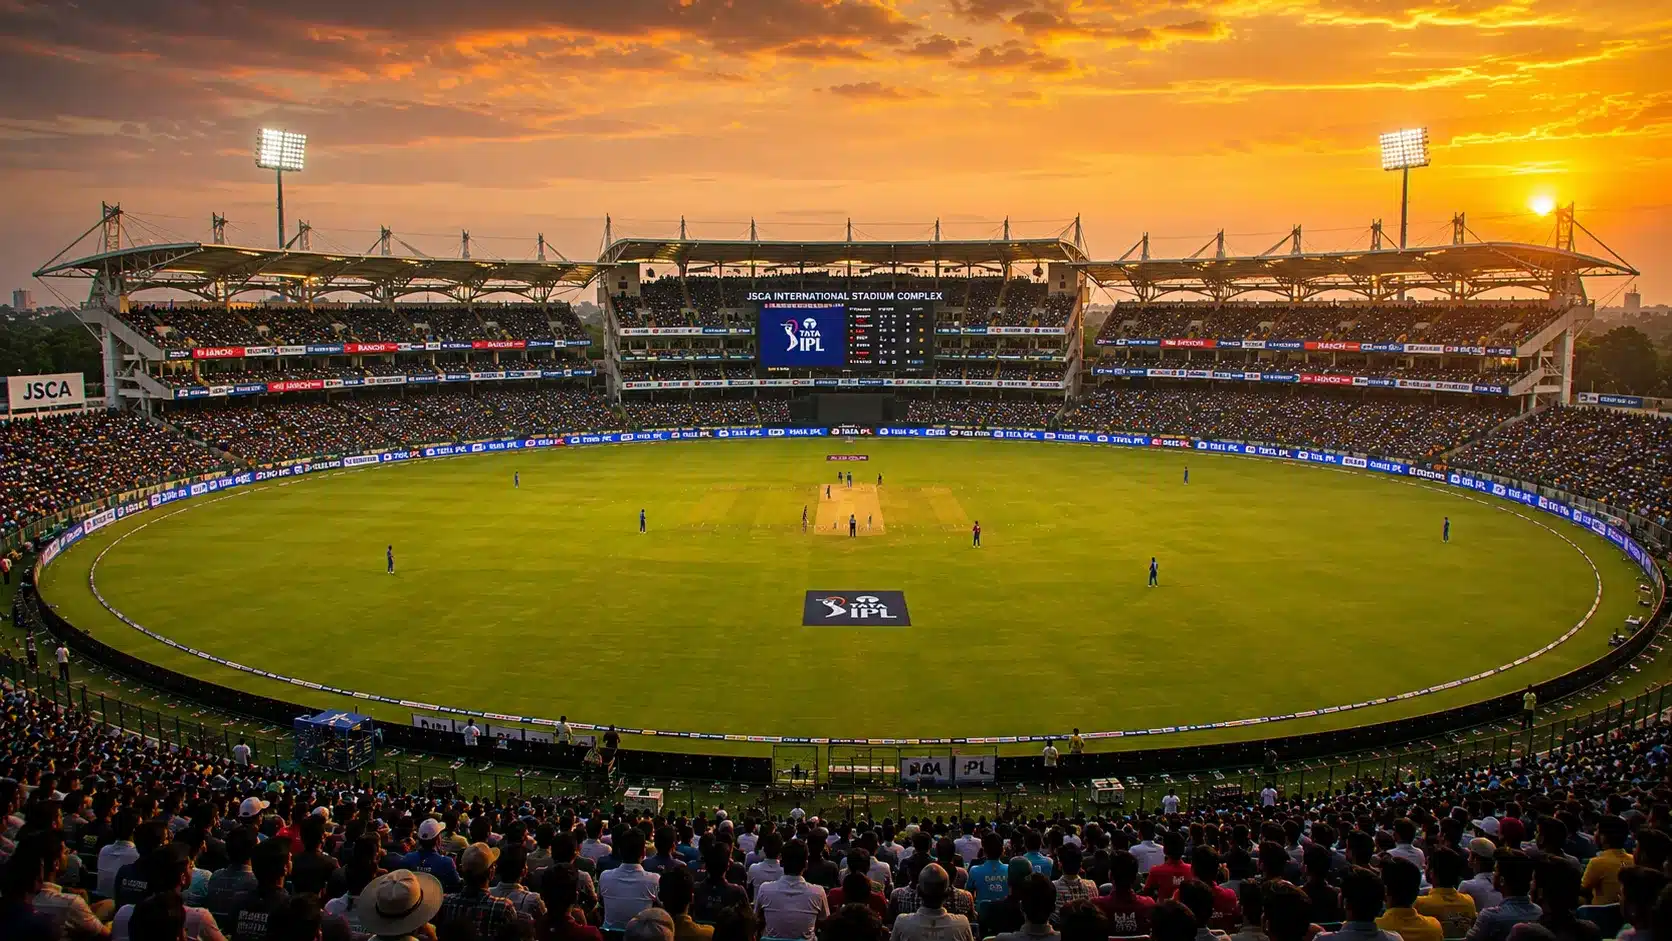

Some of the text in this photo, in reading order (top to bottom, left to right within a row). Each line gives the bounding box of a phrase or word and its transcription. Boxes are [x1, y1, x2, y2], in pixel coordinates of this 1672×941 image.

[746, 292, 943, 301] JSCA INTERNATIONAL STADIUM COMPLEX
[800, 337, 825, 352] IPL
[23, 381, 72, 400] JSCA
[850, 608, 897, 618] IPL
